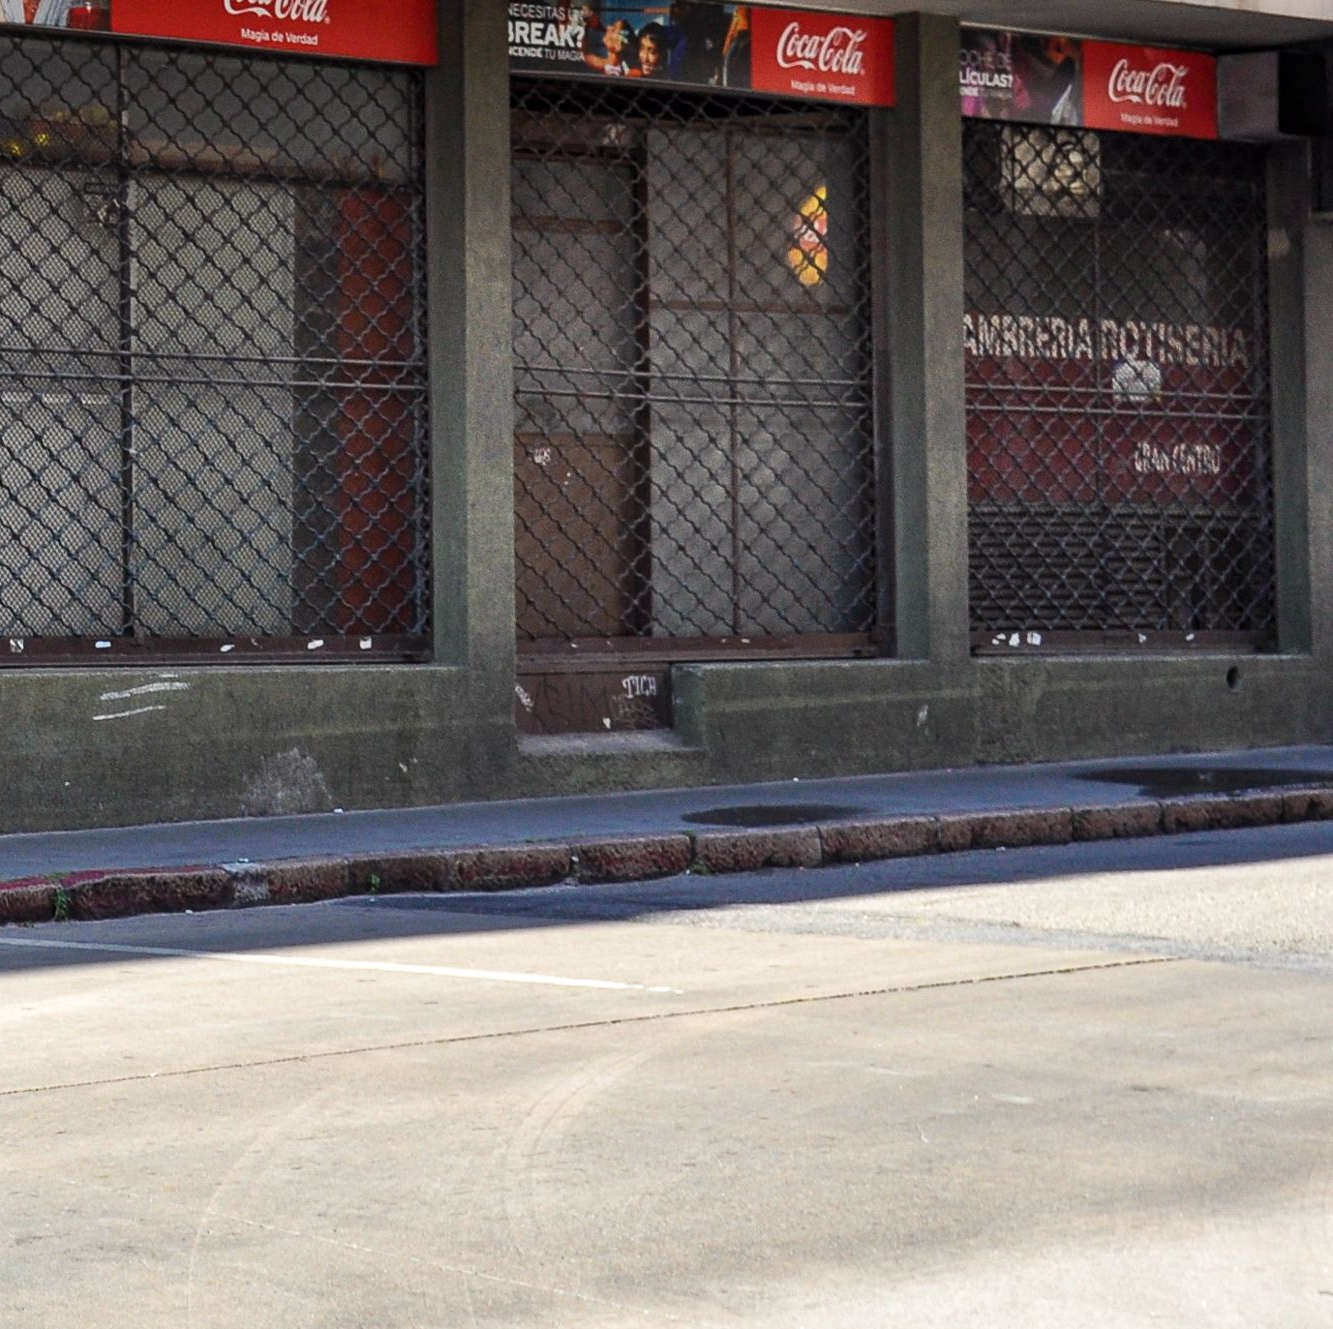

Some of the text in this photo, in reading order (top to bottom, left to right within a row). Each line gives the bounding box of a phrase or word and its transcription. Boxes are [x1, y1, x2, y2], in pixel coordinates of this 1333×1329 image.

[241, 27, 318, 46] Magia de Verdad
[776, 21, 867, 75] Coca-Cola
[1108, 58, 1189, 108] Coca-Cola
